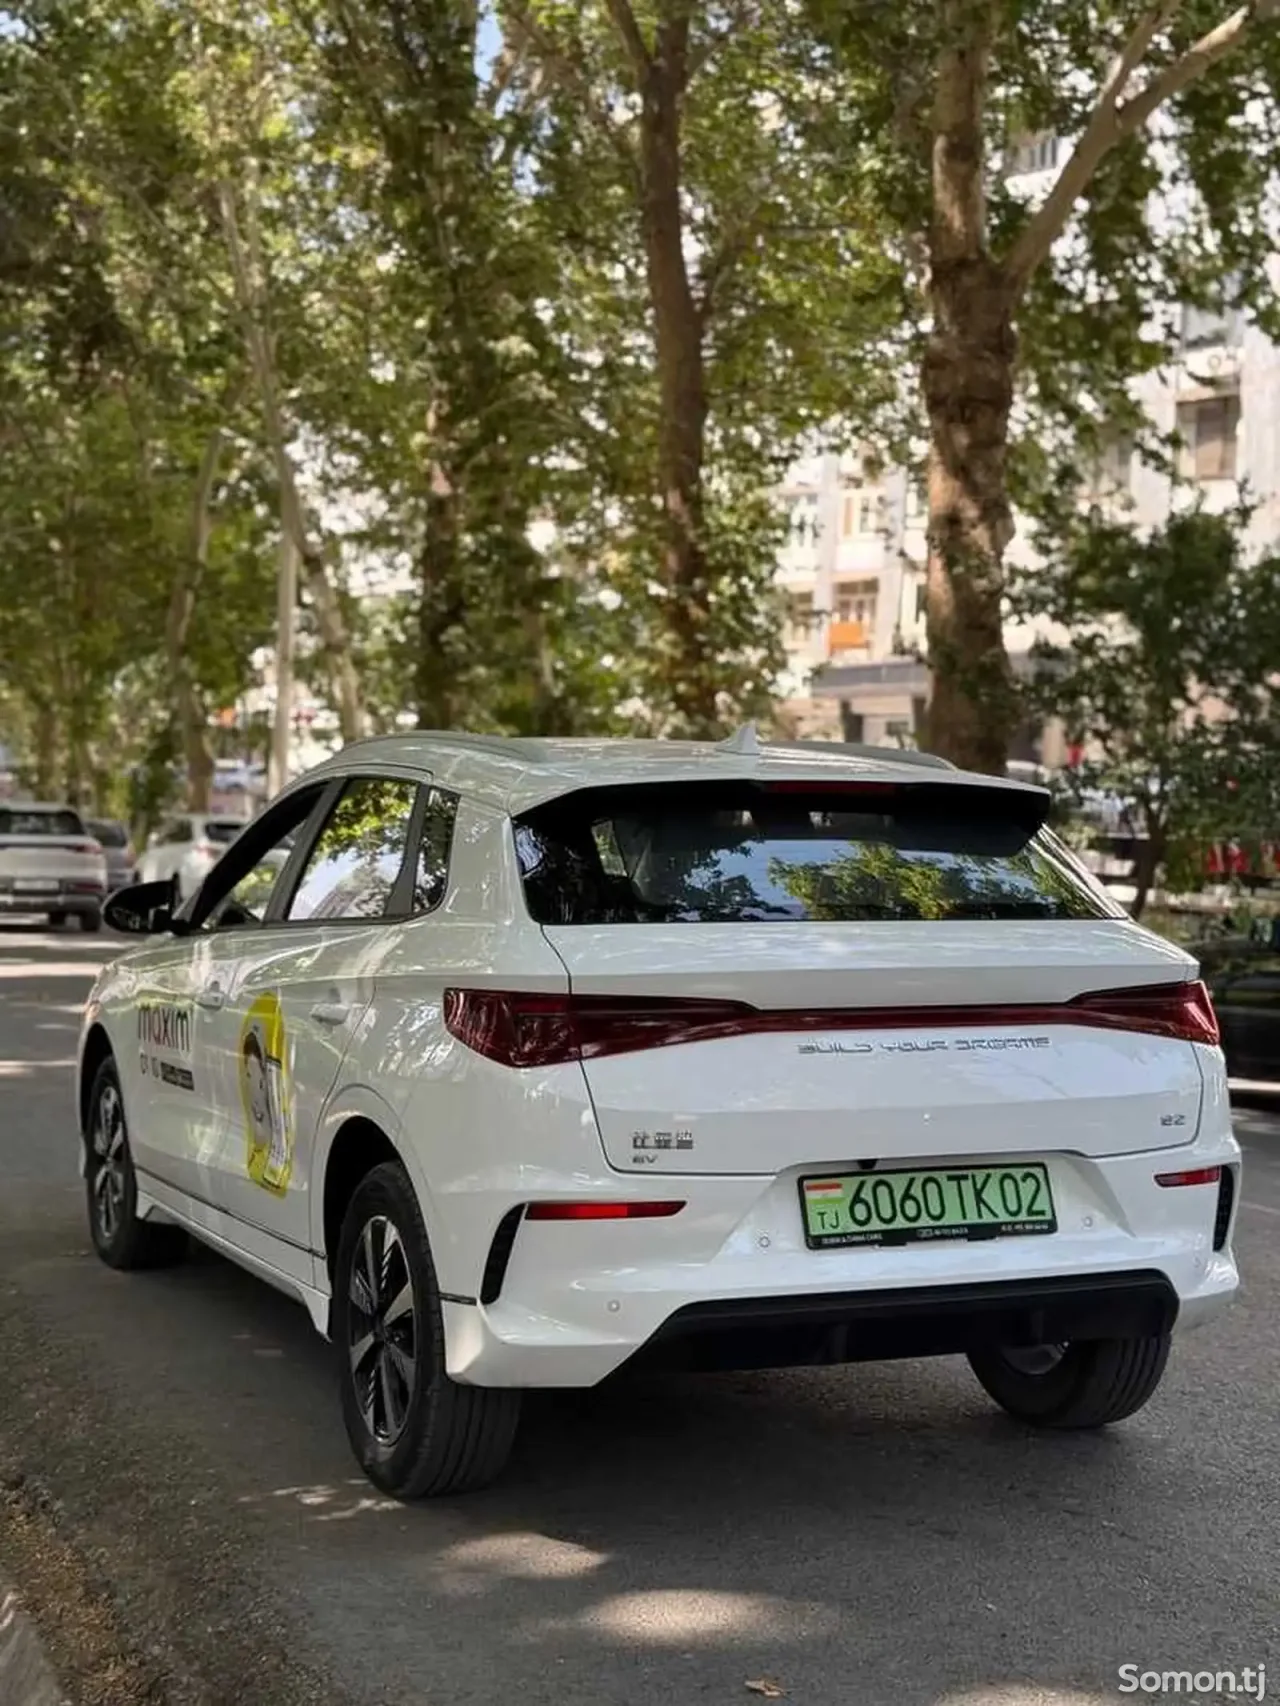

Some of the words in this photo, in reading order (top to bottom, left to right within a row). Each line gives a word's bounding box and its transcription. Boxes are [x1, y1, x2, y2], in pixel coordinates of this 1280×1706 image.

[138, 1005, 190, 1053] maxim
[817, 1210, 840, 1230] TJ
[849, 1172, 1047, 1228] 6060TK02
